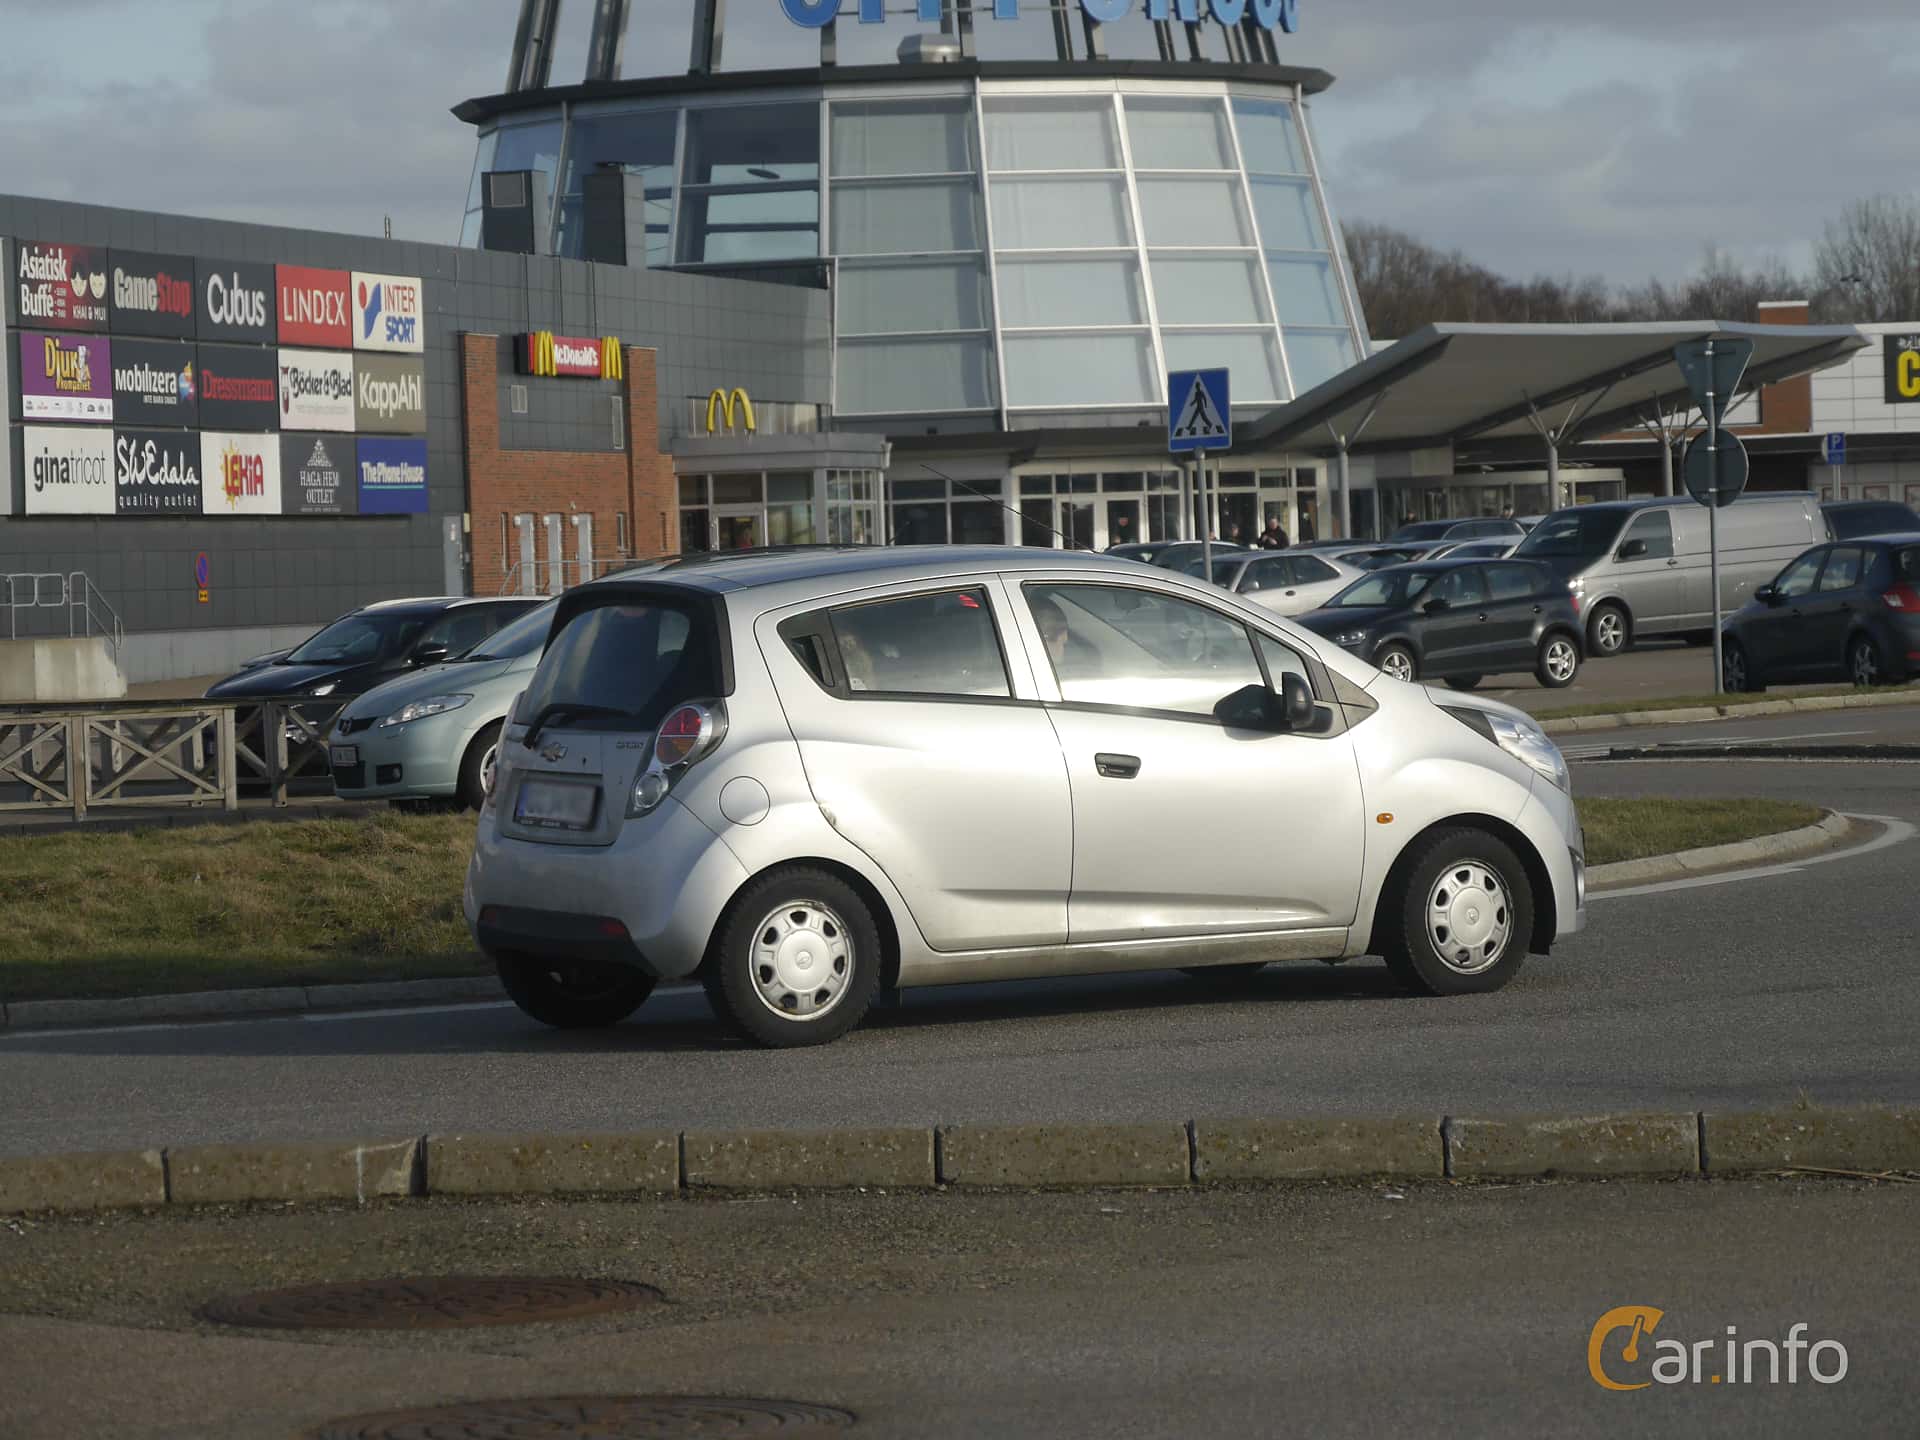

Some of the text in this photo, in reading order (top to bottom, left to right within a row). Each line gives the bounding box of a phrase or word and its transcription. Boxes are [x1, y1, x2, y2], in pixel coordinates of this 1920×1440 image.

[20, 246, 67, 282] Asiatisk
[21, 283, 54, 317] Buffé
[114, 267, 191, 317] GameStop
[207, 272, 265, 327] Cubus
[283, 287, 346, 326] LINDEX
[384, 284, 415, 312] INTER
[386, 315, 416, 343] SPORT
[202, 369, 275, 401] Dressmann
[359, 372, 421, 417] KappAhl
[1832, 434, 1841, 449] P
[300, 471, 340, 488] HAGA HEM
[119, 493, 198, 509] quality outlet
[306, 489, 334, 505] OUTLET
